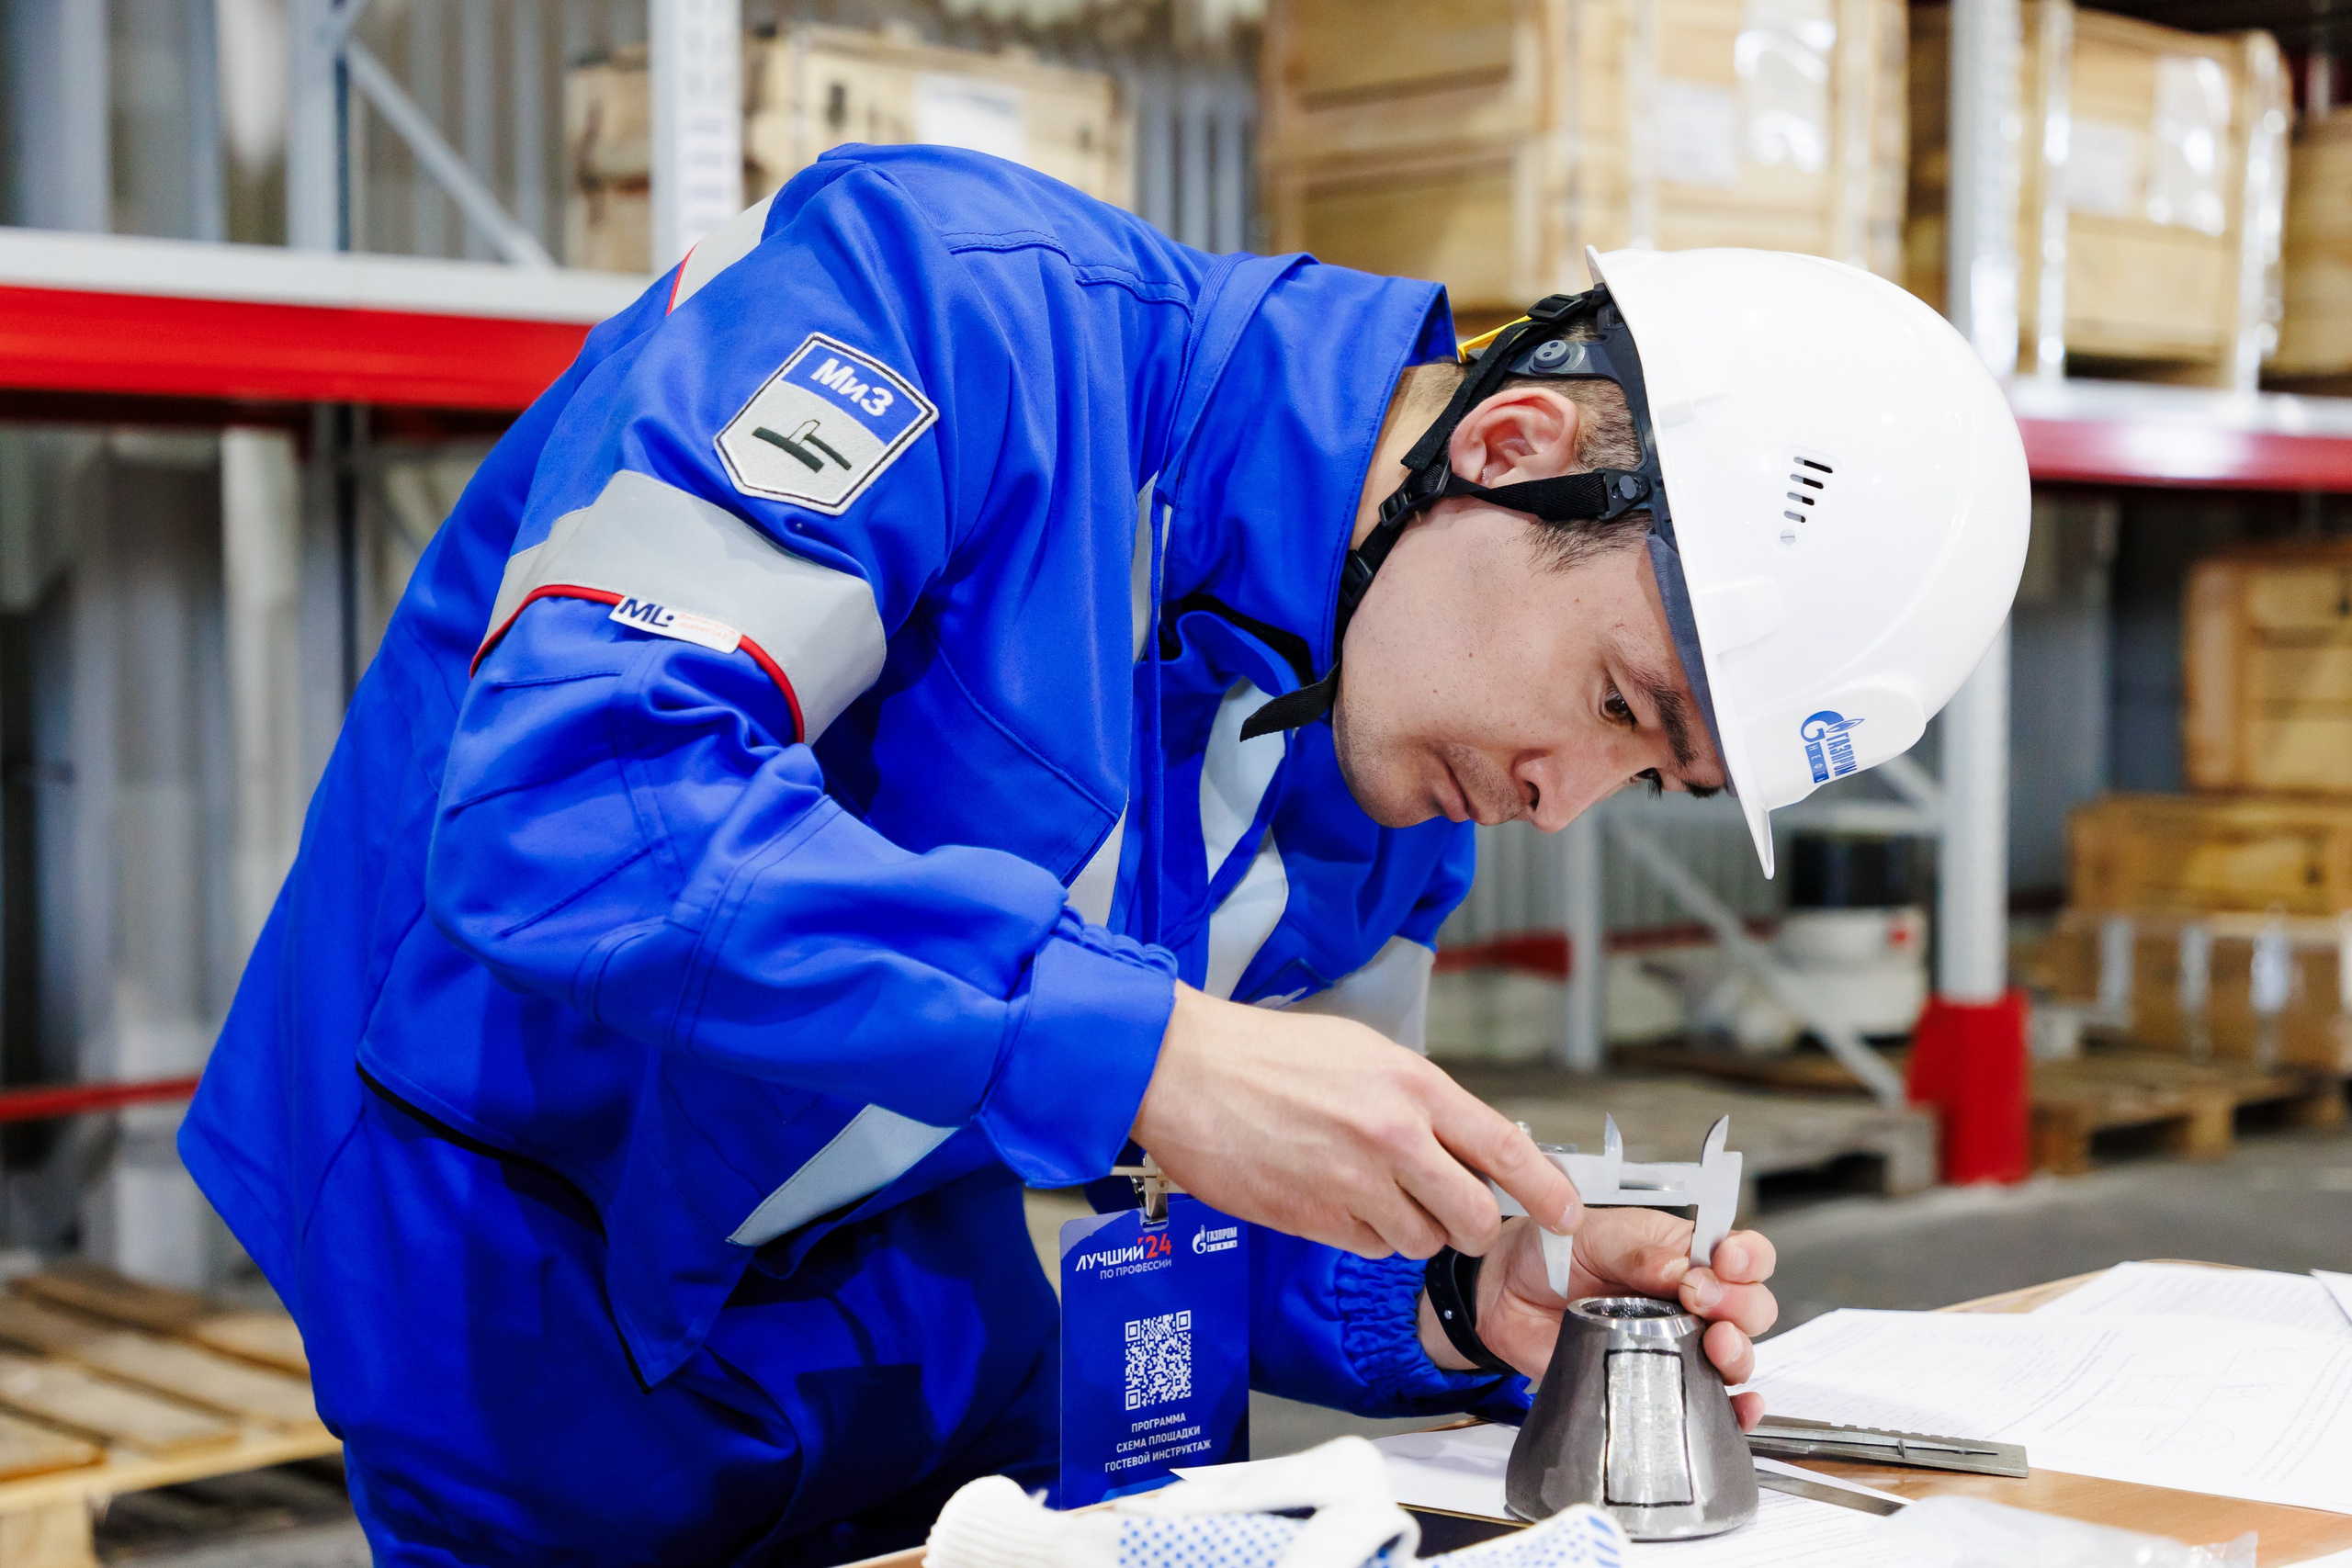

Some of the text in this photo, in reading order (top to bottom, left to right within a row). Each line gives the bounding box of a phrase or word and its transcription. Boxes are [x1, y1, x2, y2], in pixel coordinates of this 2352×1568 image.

[1826, 731, 1858, 777] ГАЗПРОМ
[1100, 1258, 1172, 1280] ПО ПРОФЕССИИ
[1131, 1412, 1187, 1433] ПРОГРАММА
[1115, 1425, 1201, 1453] СХЕМА ПЛОЩАДКИ
[1104, 1438, 1212, 1472] ГОСТЕВОЙ ИНСТРУКТАЖ
